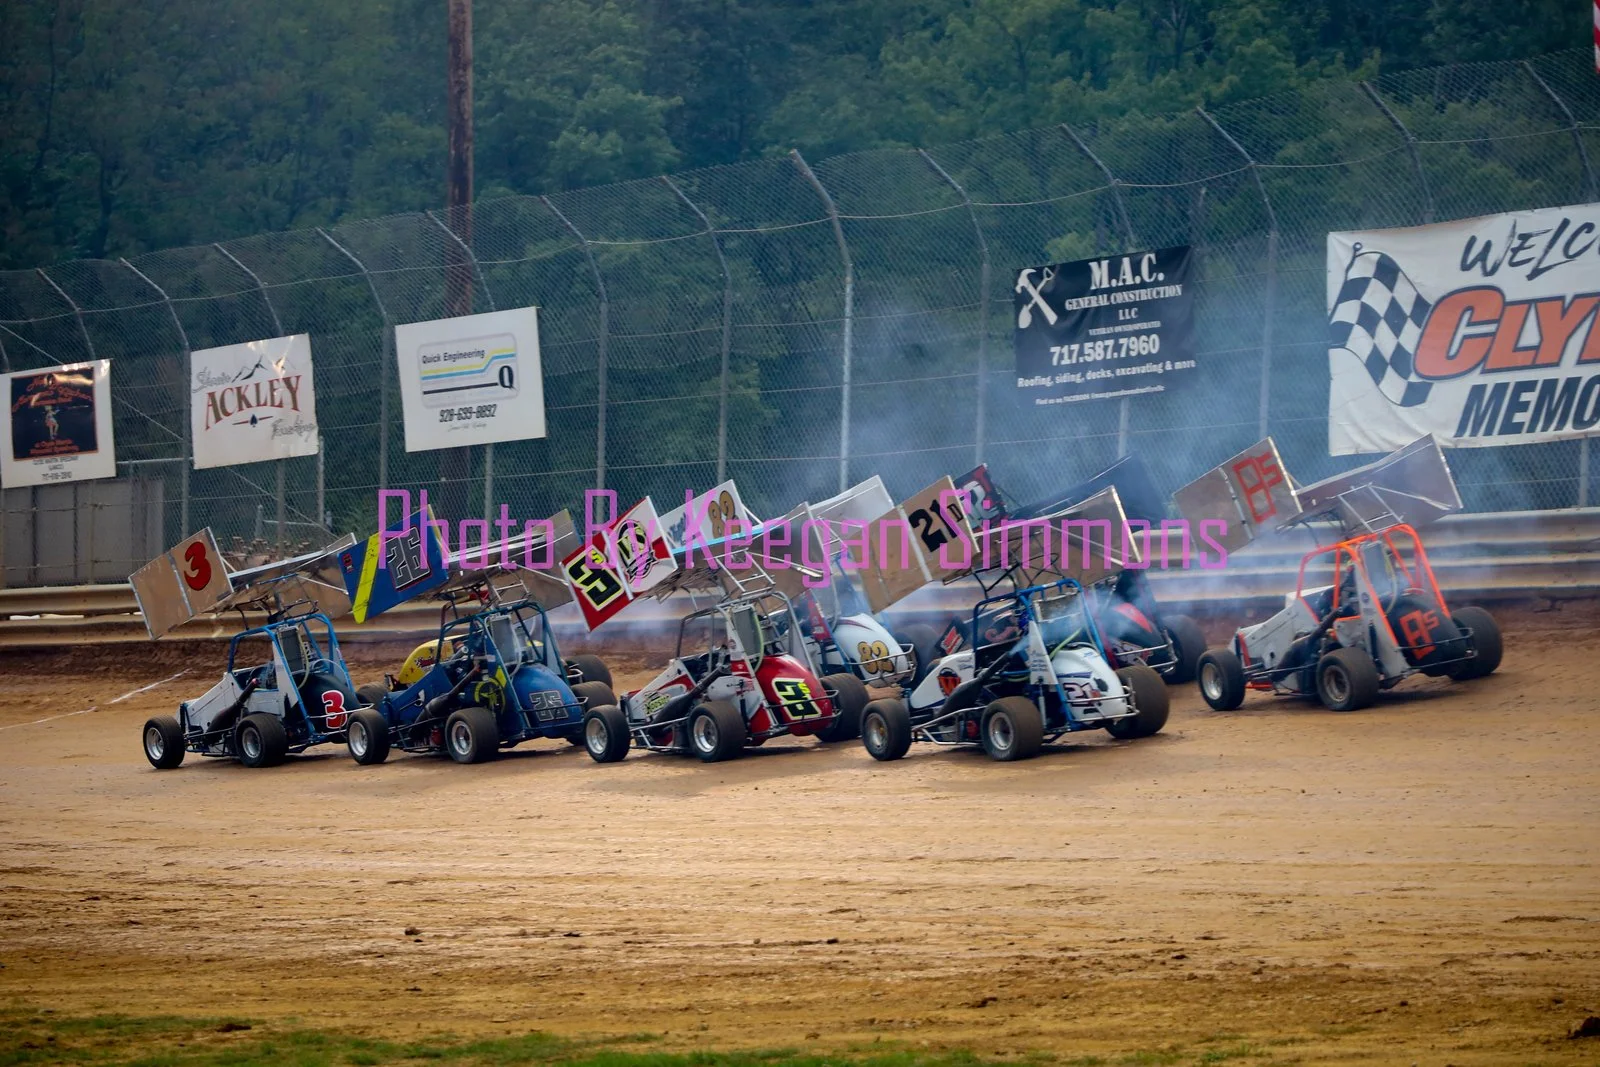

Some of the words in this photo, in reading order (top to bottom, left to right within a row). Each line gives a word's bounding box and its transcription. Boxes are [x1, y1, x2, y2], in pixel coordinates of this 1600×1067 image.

[1460, 217, 1600, 281] WELC
[1088, 252, 1165, 290] M.A.C.
[1065, 294, 1110, 311] GENERAL
[1110, 284, 1182, 305] CONSTRUCTION
[1118, 308, 1139, 320] LLC
[422, 354, 441, 364] Quick
[443, 349, 485, 362] Engineering
[1050, 333, 1160, 366] 717.587.7960
[499, 365, 515, 390] Q
[1017, 375, 1054, 388] Roofing,
[1055, 371, 1085, 384] siding,
[1086, 367, 1115, 380] decks,
[1116, 361, 1164, 377] excavating
[1164, 360, 1173, 371] &
[1174, 359, 1197, 370] more
[205, 375, 302, 430] ACKLEY
[1453, 375, 1600, 438] MEMO
[183, 540, 212, 591] 3
[378, 526, 433, 591] 26
[857, 640, 895, 674] 82
[321, 689, 348, 729] 3
